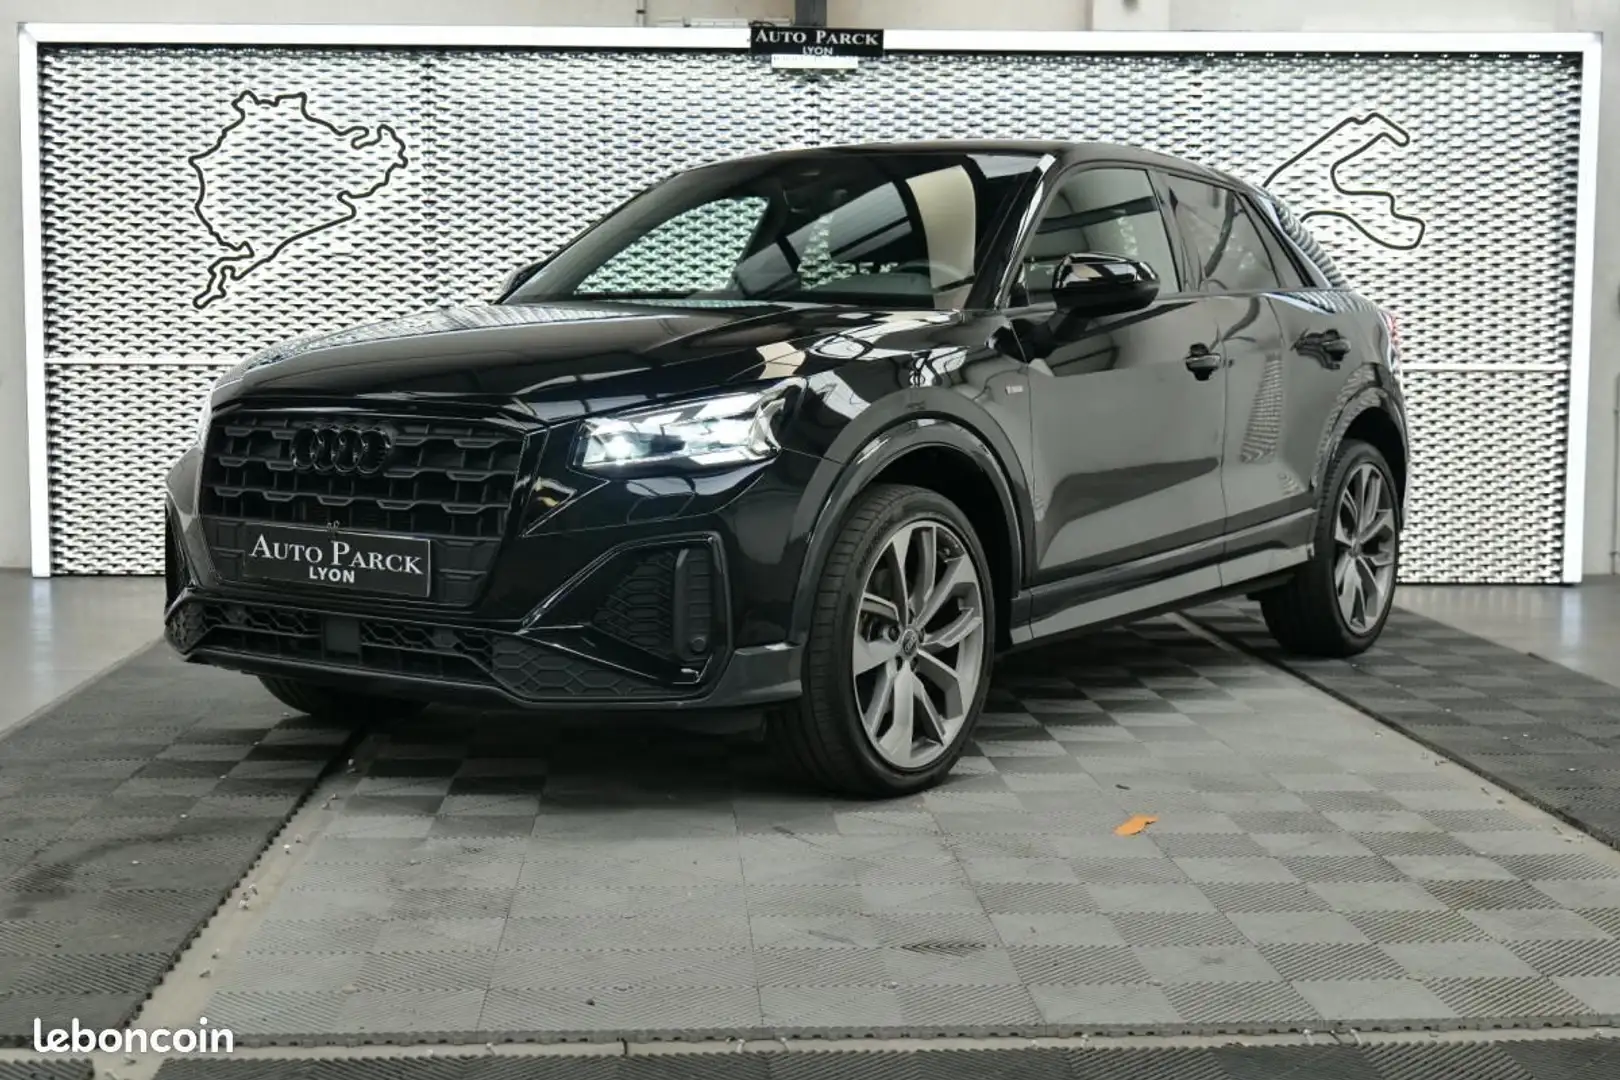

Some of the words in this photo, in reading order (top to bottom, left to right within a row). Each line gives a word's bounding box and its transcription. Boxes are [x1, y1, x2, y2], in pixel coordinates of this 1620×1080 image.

[755, 29, 807, 43] AUTO
[816, 30, 879, 45] PARCK
[802, 46, 833, 56] LYON
[249, 534, 323, 563] AUTO
[330, 540, 424, 575] PARCK
[308, 566, 355, 583] LYON
